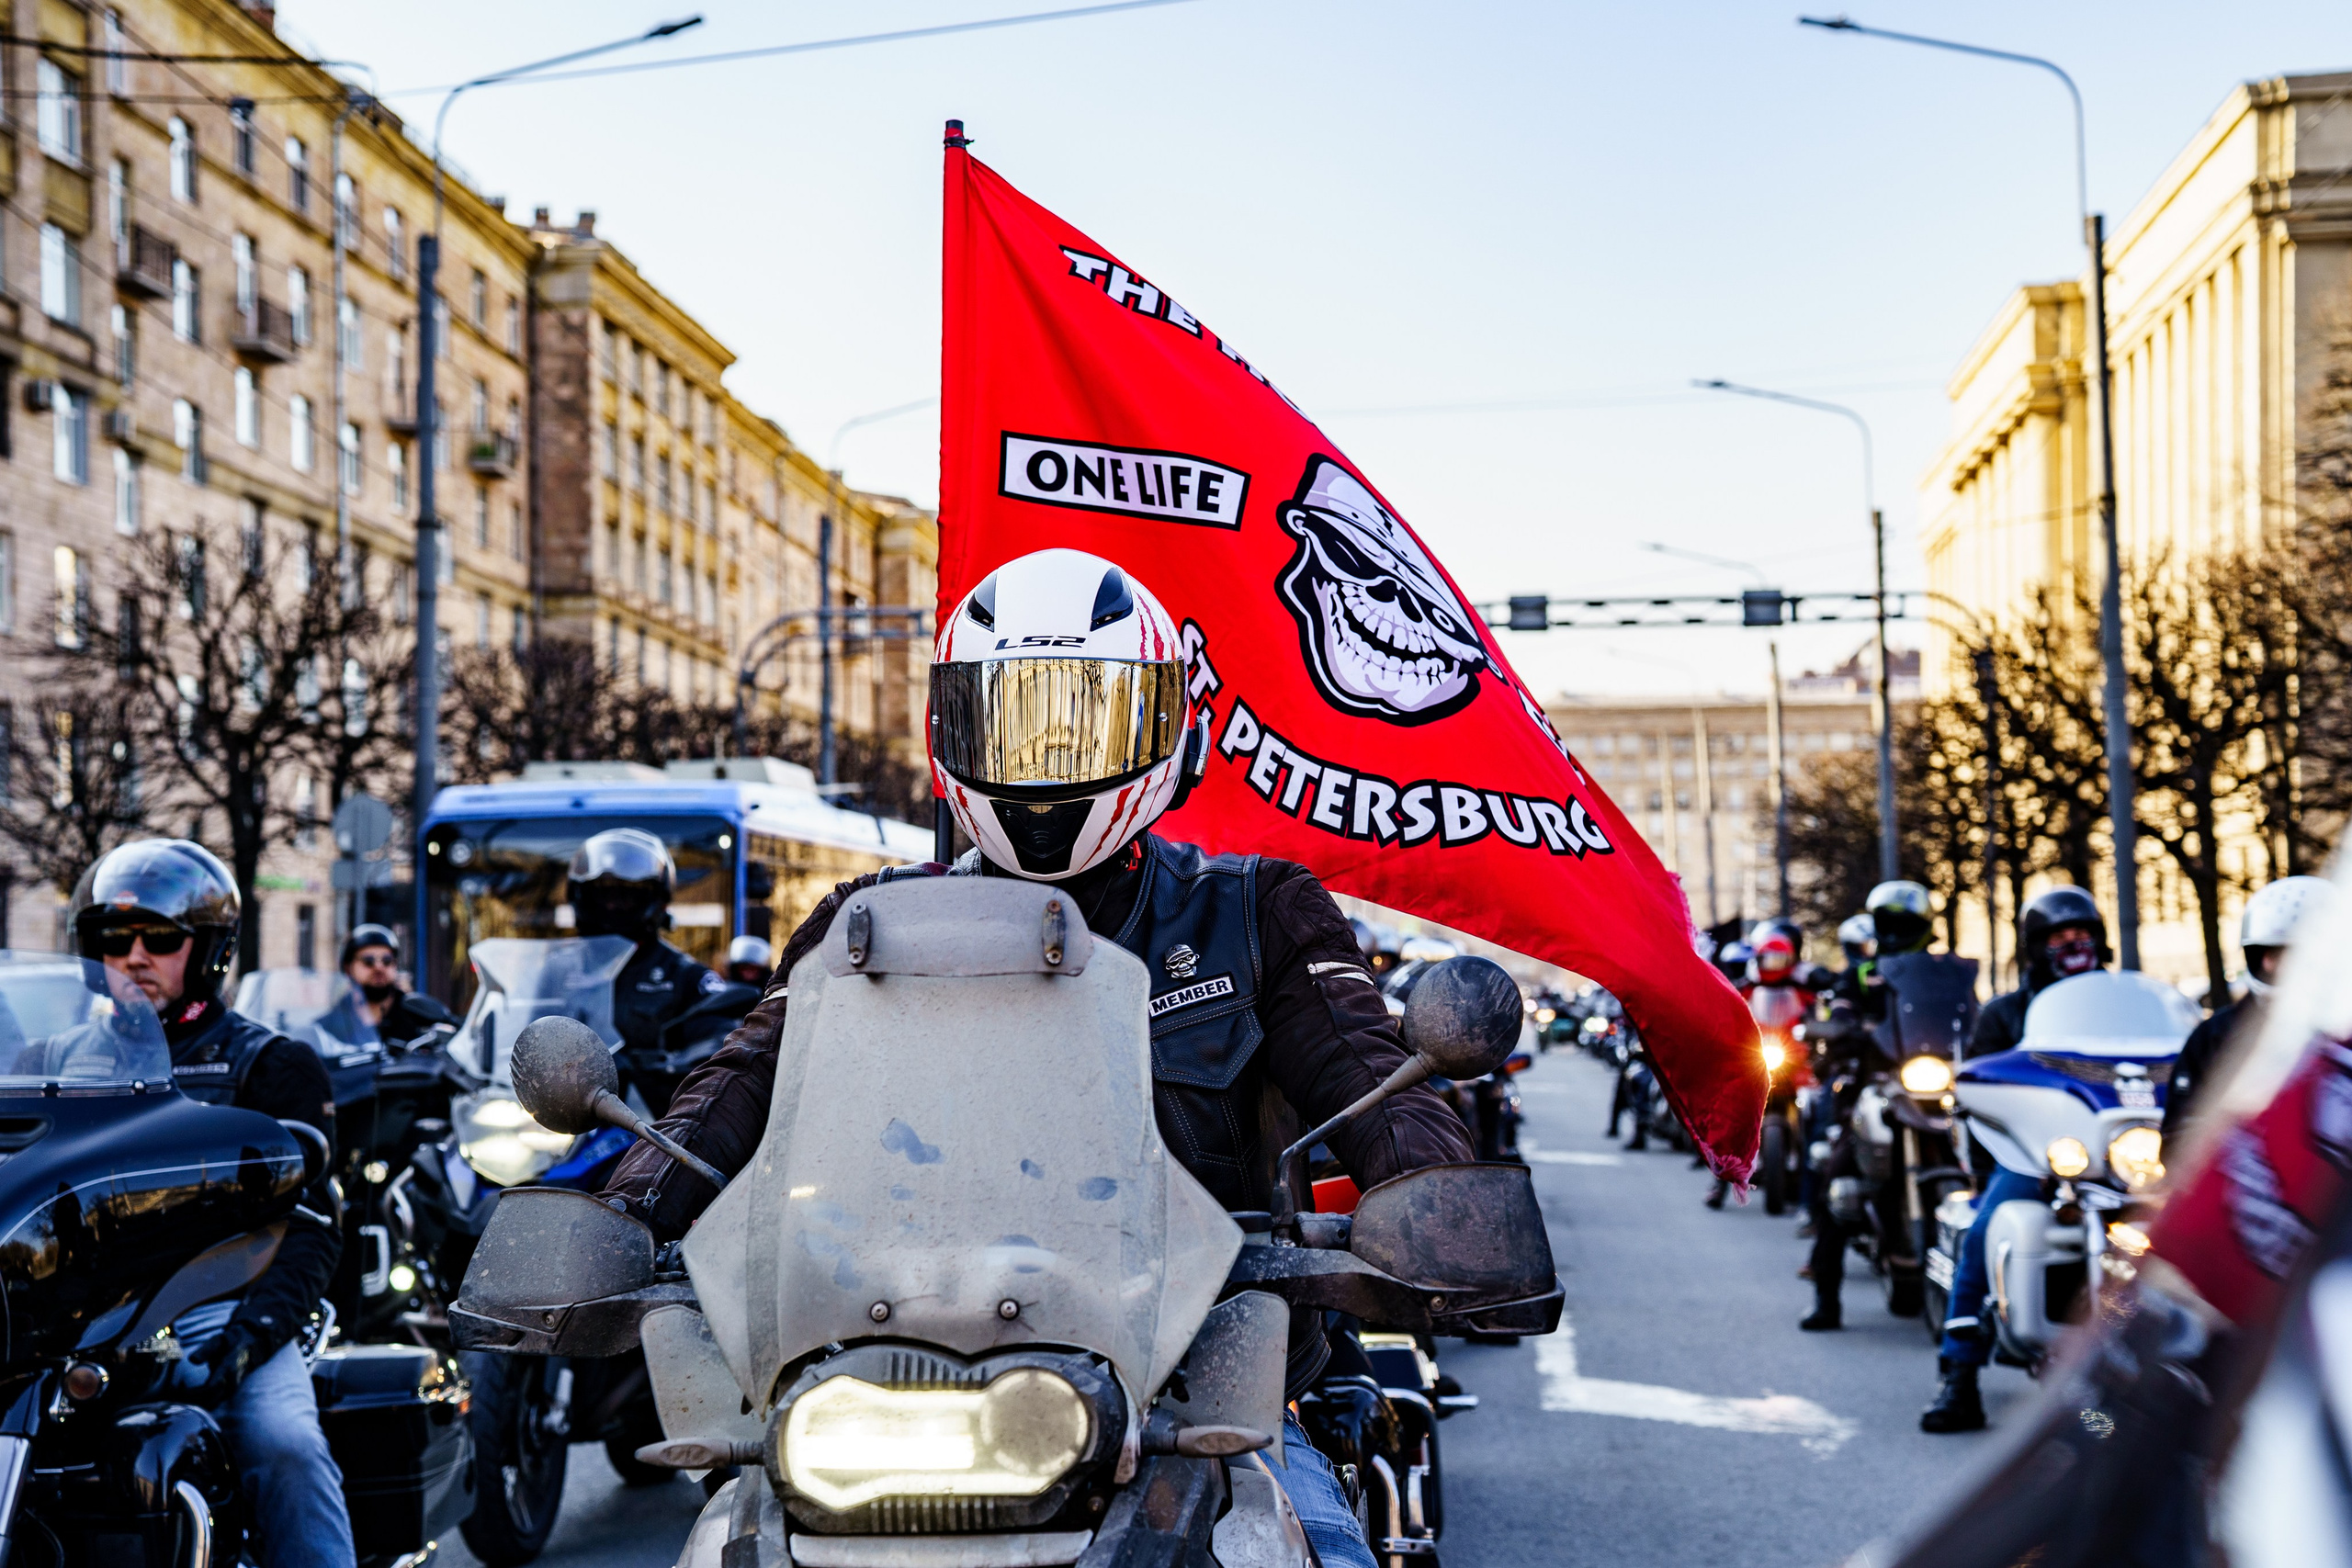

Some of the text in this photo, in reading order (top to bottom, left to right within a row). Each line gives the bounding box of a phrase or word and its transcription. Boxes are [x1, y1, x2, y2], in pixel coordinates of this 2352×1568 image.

[1061, 246, 1201, 337] THE
[1026, 449, 1225, 514] ONE LIFE
[995, 635, 1087, 651] LS2
[1217, 699, 1612, 855] PETERSBURG
[1151, 980, 1229, 1014] MEMBER
